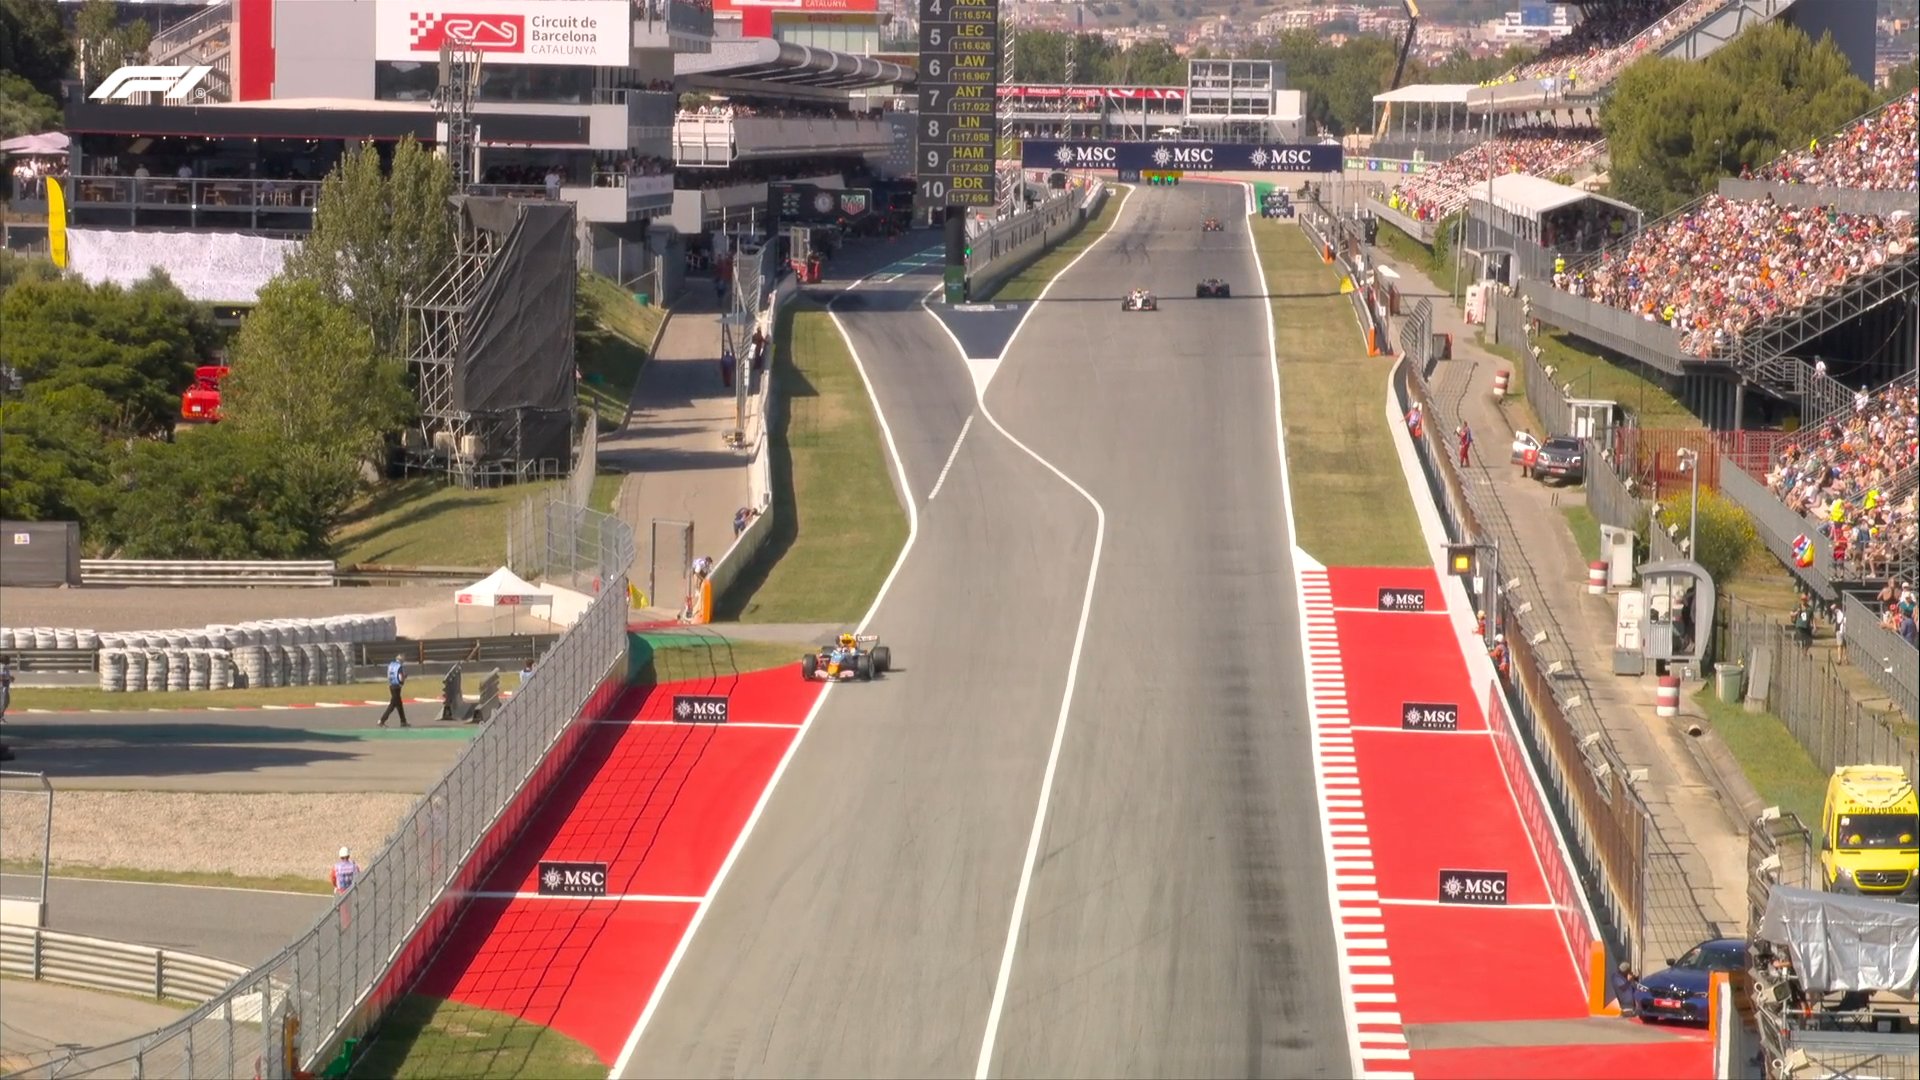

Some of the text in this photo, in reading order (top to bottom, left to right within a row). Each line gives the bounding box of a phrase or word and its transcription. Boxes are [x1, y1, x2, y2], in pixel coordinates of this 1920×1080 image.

[929, 0, 942, 15] 4
[954, 11, 992, 20] 1:16.574
[532, 16, 597, 28] Circuit de
[532, 30, 597, 42] Barcelona
[957, 25, 984, 36] LEC
[930, 28, 941, 46] 5
[531, 44, 597, 55] CATALUNYA
[955, 55, 985, 67] LAW
[929, 59, 940, 76] 6
[953, 72, 991, 81] 1:16.967
[955, 86, 983, 97] ANT
[929, 90, 940, 106] 7
[953, 102, 990, 112] 1:17.022
[958, 116, 980, 128] LIN
[928, 120, 939, 137] 8
[952, 133, 990, 142] 1:17.058
[953, 146, 984, 158] HAM
[1076, 146, 1116, 161] MSC
[1173, 148, 1214, 162] MSC
[1271, 149, 1312, 164] MSC
[927, 150, 939, 168] 9
[951, 163, 989, 173] 1:17.430
[953, 177, 983, 189] BOR
[922, 181, 944, 198] 10
[1396, 594, 1424, 605] MSC
[693, 702, 726, 715] MSC
[1423, 710, 1456, 723] MSC
[564, 870, 604, 886] MSC
[1464, 879, 1505, 894] MSC
